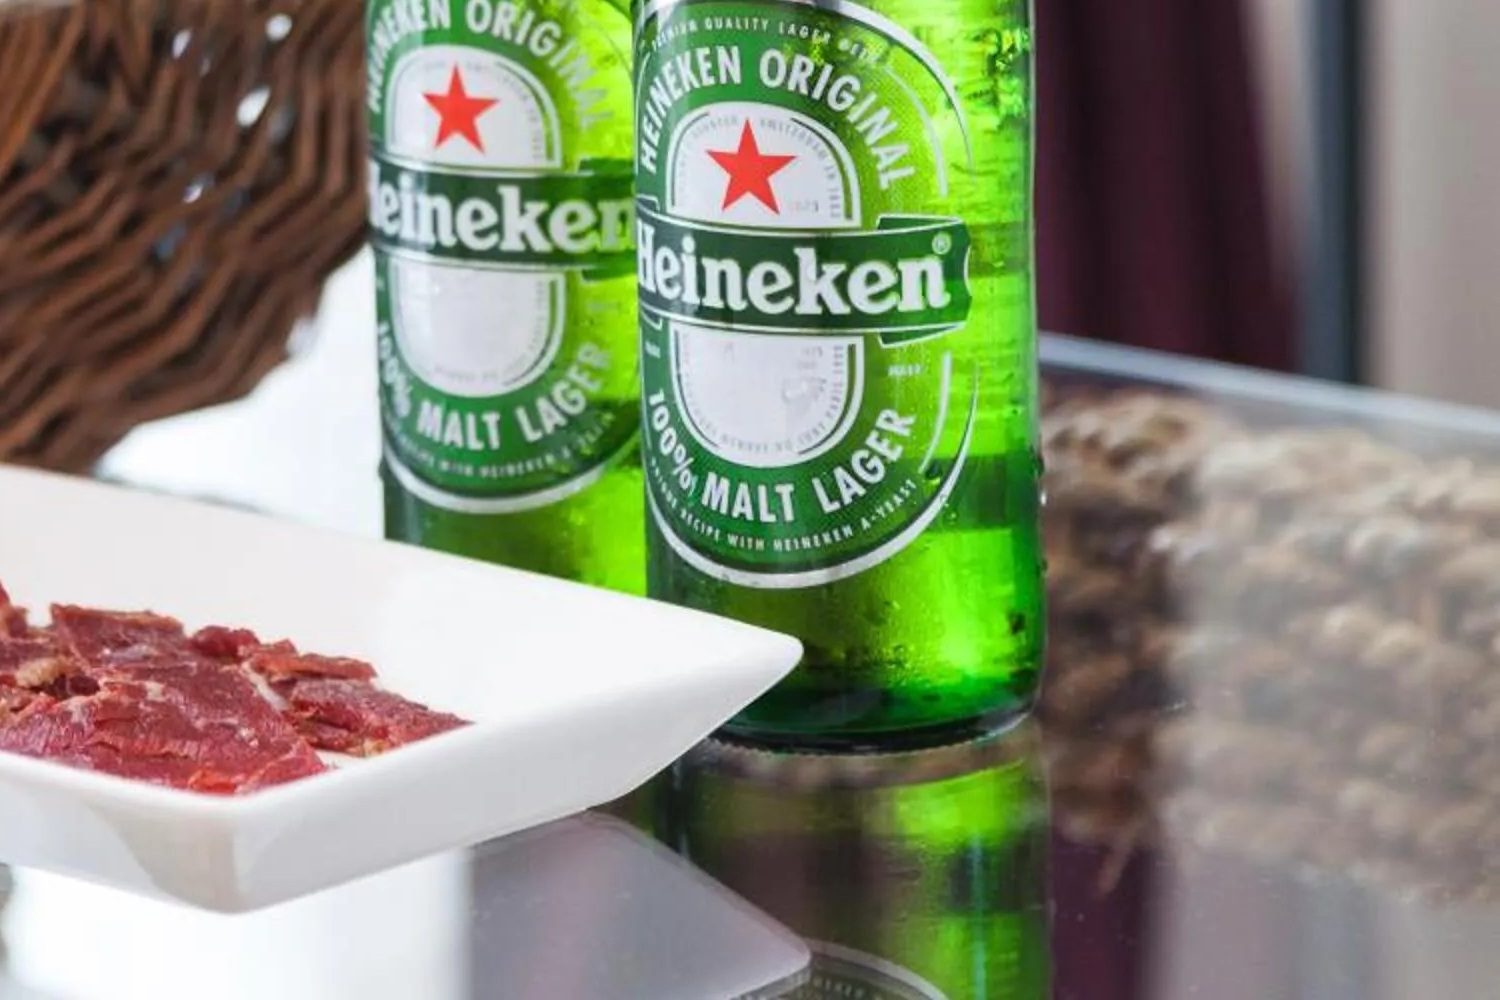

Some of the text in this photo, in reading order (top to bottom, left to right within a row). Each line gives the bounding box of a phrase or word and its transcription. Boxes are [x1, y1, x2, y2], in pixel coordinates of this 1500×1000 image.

[704, 15, 770, 31] QUALITY
[778, 20, 831, 46] LAGER
[640, 45, 742, 176] HEINEKEN
[758, 48, 916, 191] ORIGINAL
[637, 218, 951, 316] Heineken
[417, 399, 500, 452] MALT
[513, 341, 613, 443] LAGER
[647, 388, 694, 491] 100%
[701, 471, 795, 523] MALT
[811, 408, 918, 514] LAGER
[726, 532, 766, 552] WITH
[772, 524, 854, 552] HEINEKEN
